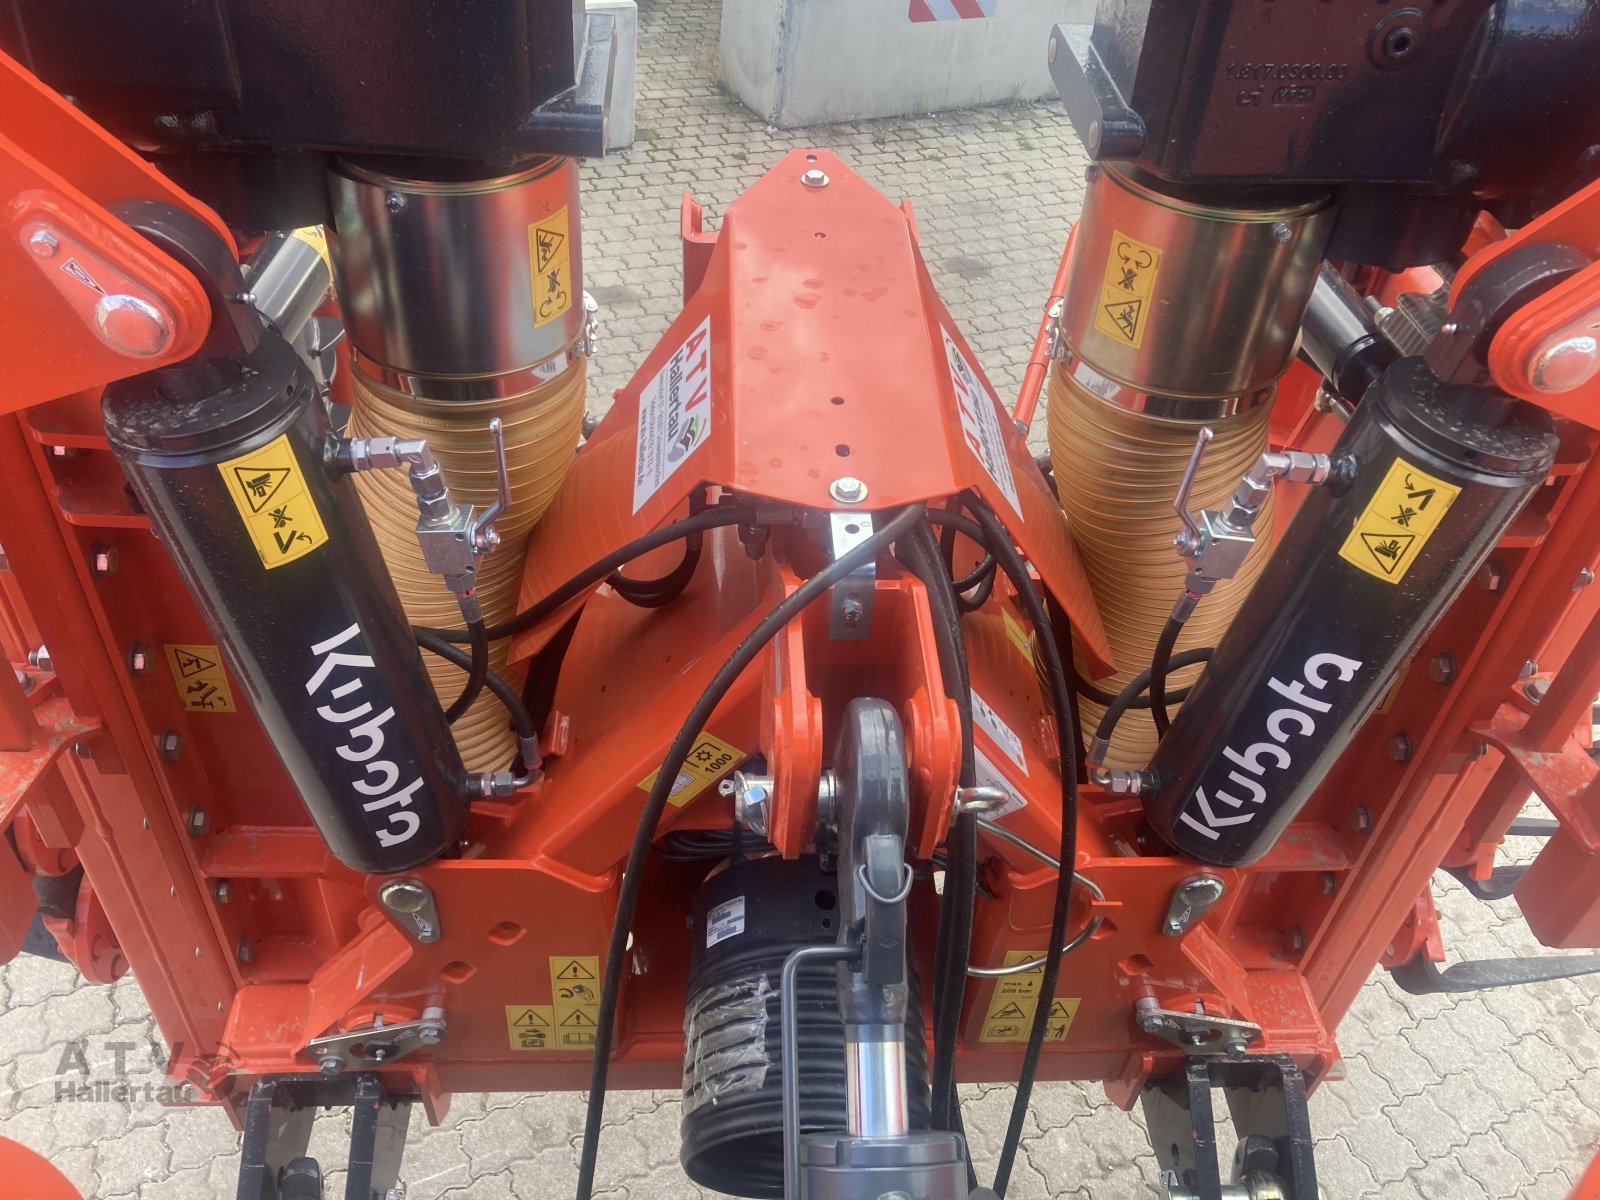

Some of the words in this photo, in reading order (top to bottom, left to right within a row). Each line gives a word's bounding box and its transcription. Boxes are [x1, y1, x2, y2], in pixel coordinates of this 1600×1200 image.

[667, 347, 684, 443] Hallertau
[305, 622, 425, 848] Kubota
[705, 753, 733, 774] 1000
[1179, 652, 1363, 841] Kubota
